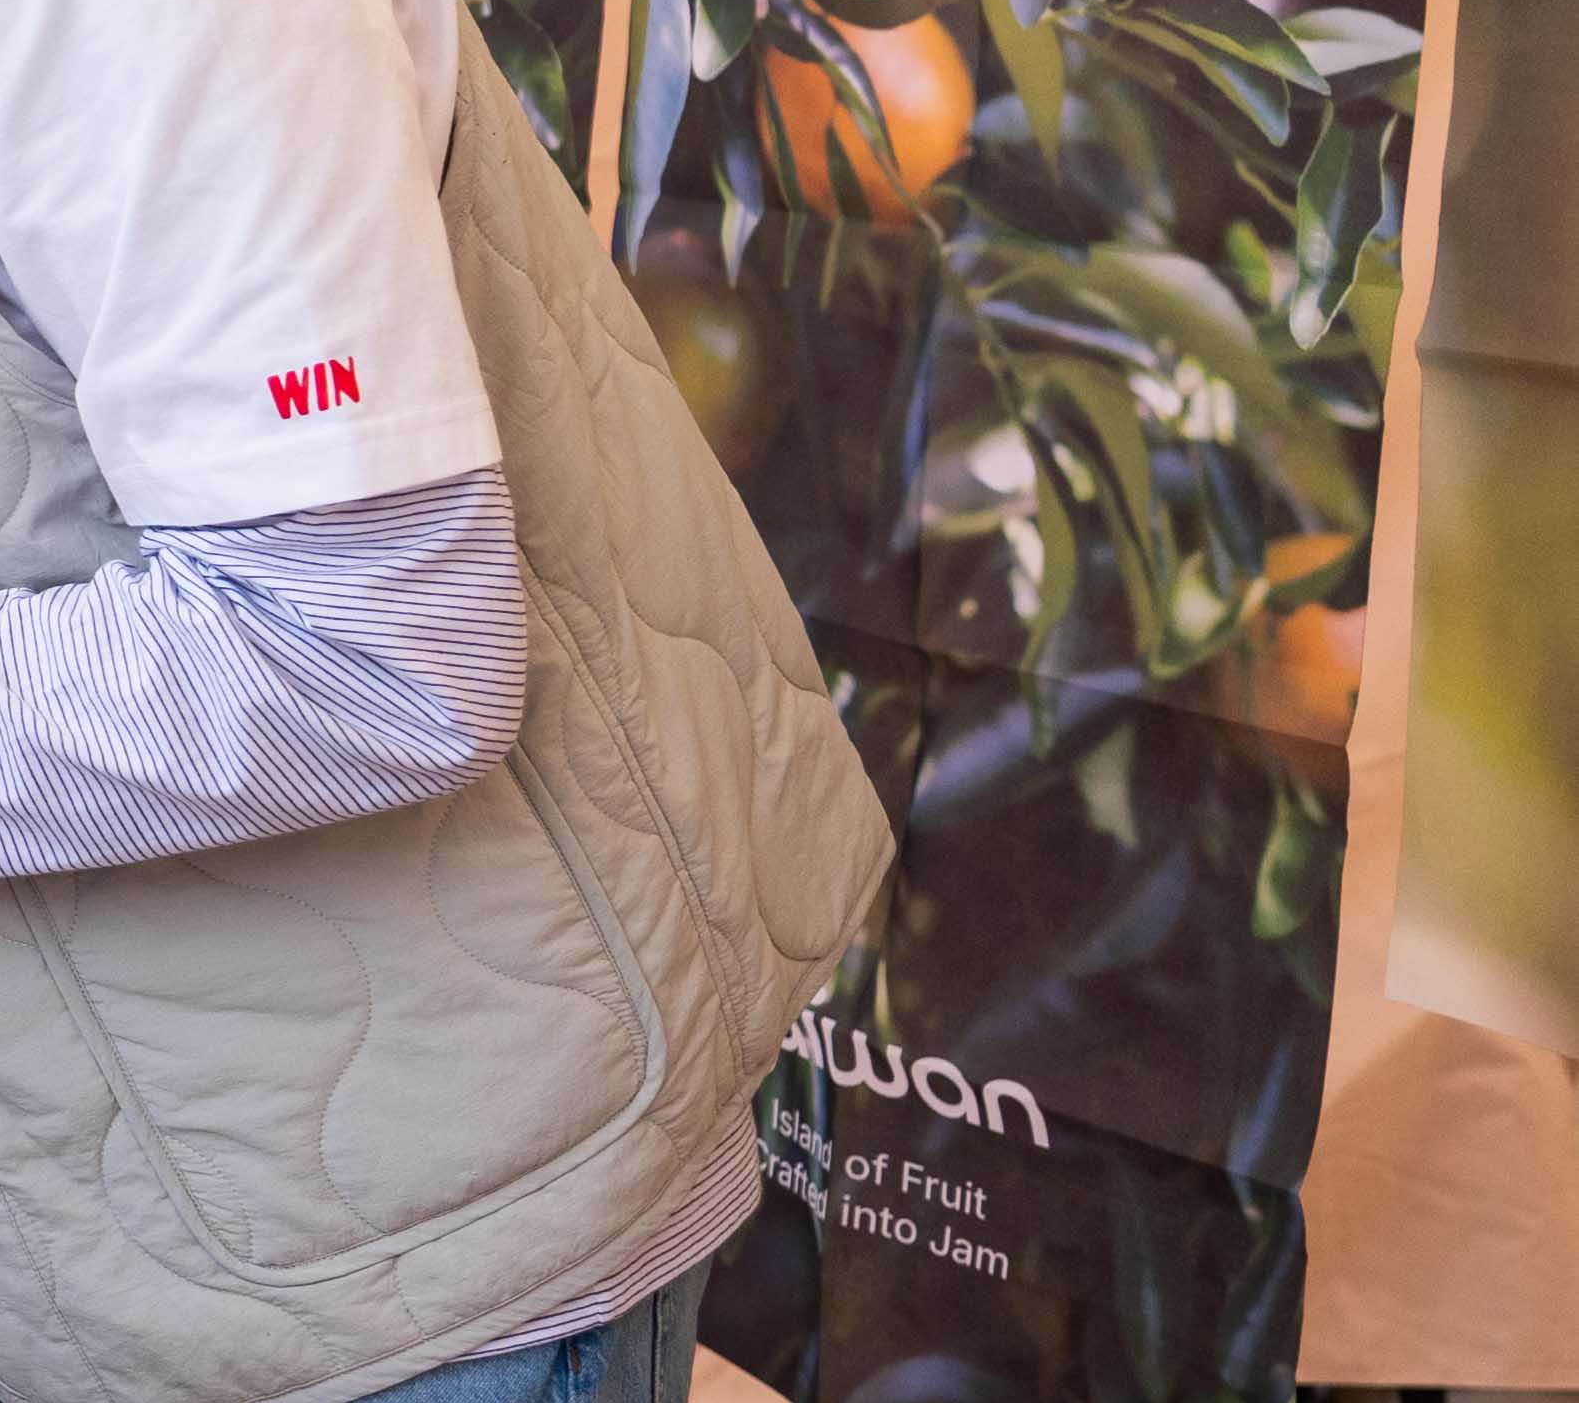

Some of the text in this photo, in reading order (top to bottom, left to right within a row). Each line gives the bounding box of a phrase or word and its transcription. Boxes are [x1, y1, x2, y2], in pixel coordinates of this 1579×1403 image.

[267, 356, 360, 420] WIN
[771, 1098, 988, 1221] Island of Fruit
[839, 1195, 918, 1245] into
[929, 1225, 1010, 1281] Jam
